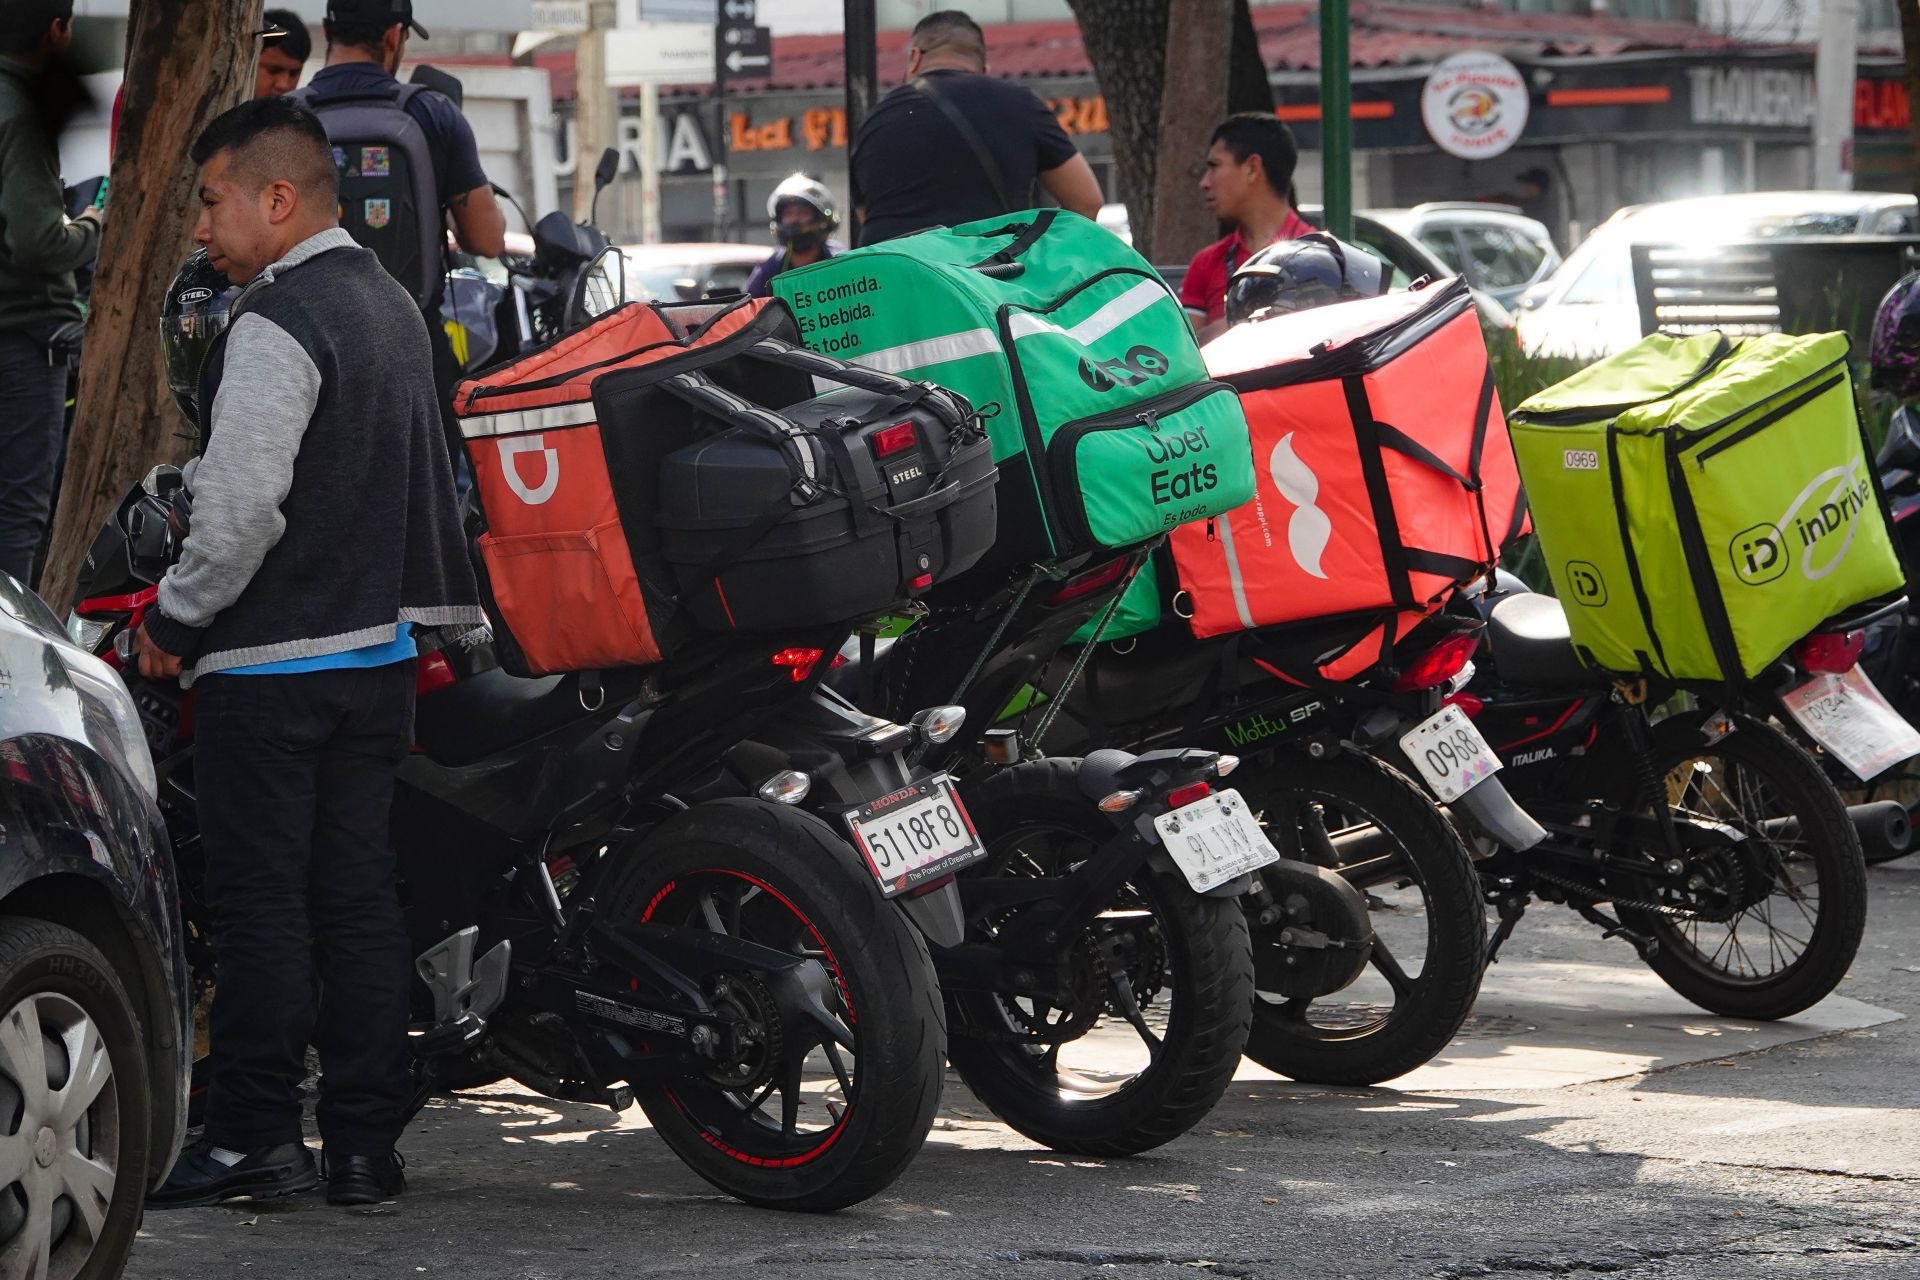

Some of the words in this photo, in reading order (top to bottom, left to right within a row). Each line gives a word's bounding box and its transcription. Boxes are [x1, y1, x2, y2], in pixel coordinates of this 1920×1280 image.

[181, 290, 208, 302] STEEL
[794, 291, 812, 309] Es
[816, 275, 883, 304] comida.
[798, 316, 816, 334] Es
[818, 302, 875, 329] bebida.
[821, 331, 862, 354] todo.
[1566, 452, 1597, 468] 0969
[892, 466, 923, 485] STEEL
[1151, 462, 1218, 506] Eats
[1164, 513, 1177, 526] Es
[1179, 504, 1208, 521] todo.
[1796, 478, 1871, 547] inDrive
[1224, 714, 1288, 748] Mottu
[871, 786, 919, 810] HONDA
[866, 804, 960, 868] 5118F8
[907, 872, 922, 881] The
[921, 863, 942, 876] Power
[941, 860, 949, 869] of
[947, 851, 973, 866] Dreams
